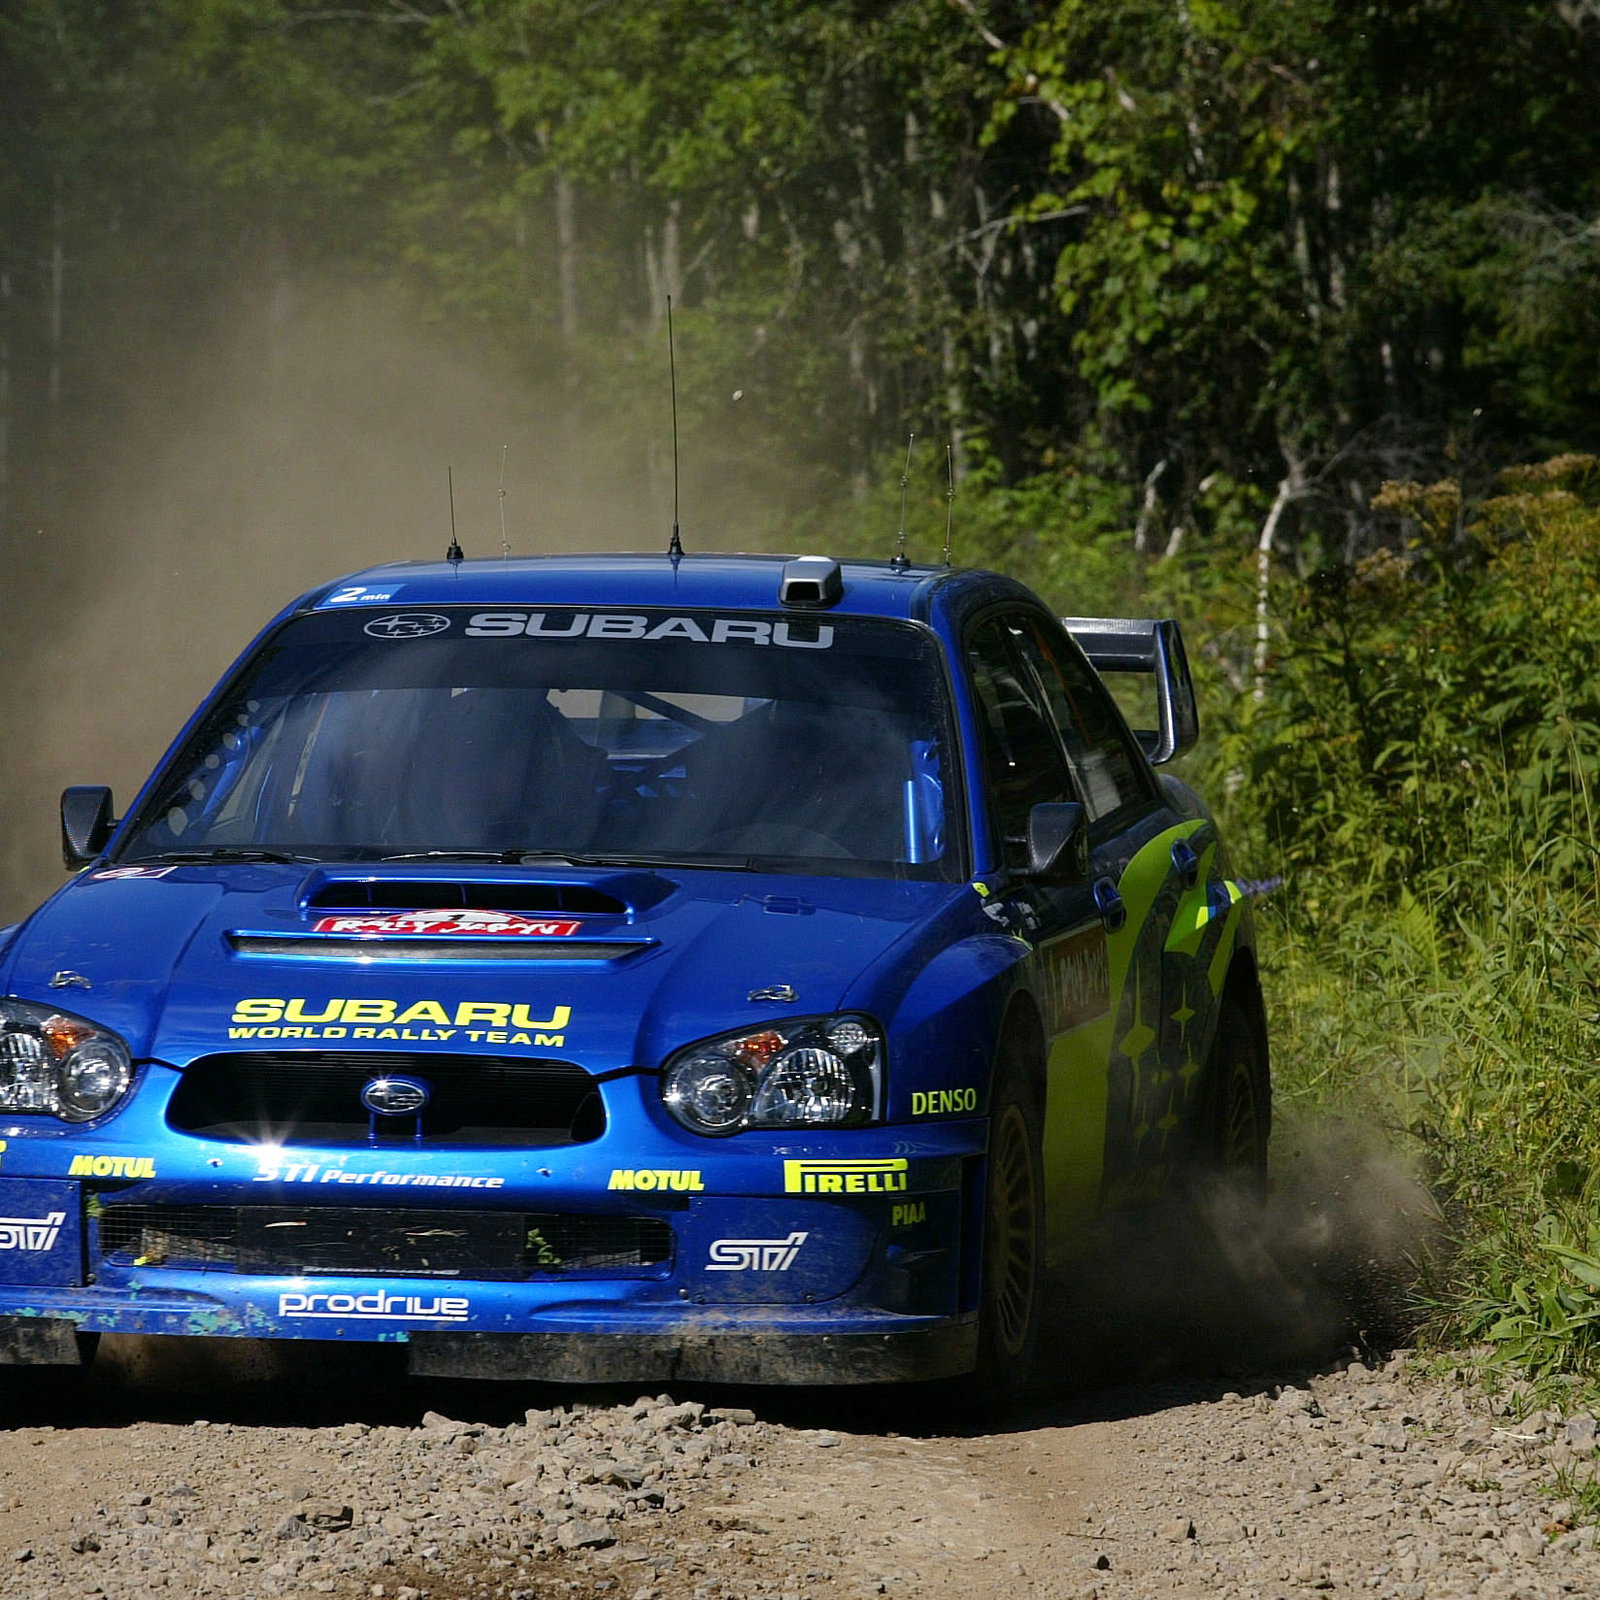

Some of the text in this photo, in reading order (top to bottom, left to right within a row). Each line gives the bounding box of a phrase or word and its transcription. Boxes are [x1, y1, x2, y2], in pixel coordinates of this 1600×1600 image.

[330, 587, 368, 602] 2
[464, 612, 834, 649] SUBARU
[231, 998, 571, 1030] SUBARU
[228, 1026, 565, 1047] WORLD RALLY TEAM
[911, 1088, 978, 1115] DENSO
[67, 1155, 157, 1178] MOTUL
[320, 1169, 505, 1188] Performance
[783, 1158, 909, 1193] PIRELLI
[607, 1169, 705, 1192] MOTUL
[892, 1201, 926, 1227] PIAA
[278, 1289, 470, 1317] prodrive
